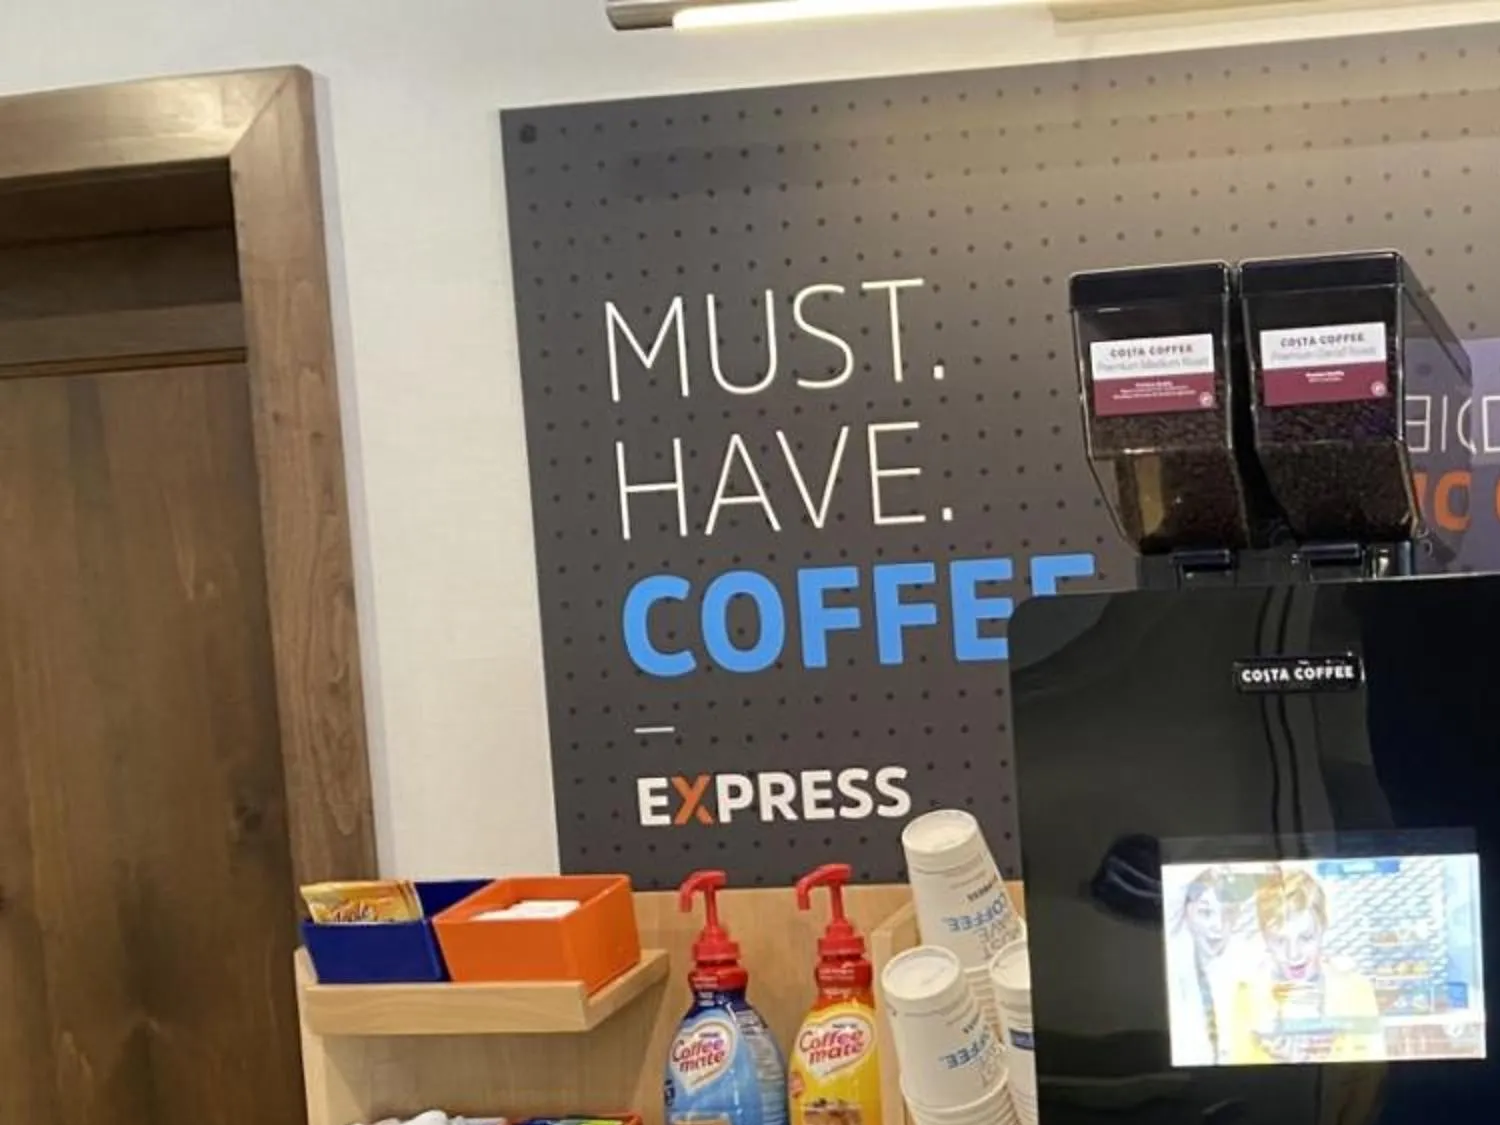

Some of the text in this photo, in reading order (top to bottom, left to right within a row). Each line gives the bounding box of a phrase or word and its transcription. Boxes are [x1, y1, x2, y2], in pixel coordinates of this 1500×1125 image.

[605, 279, 945, 403] MUST.
[616, 422, 953, 540] HAVE.
[1241, 665, 1354, 683] COSTA COFFEE
[637, 766, 911, 827] EXPRESS
[800, 1030, 865, 1053] Coffee
